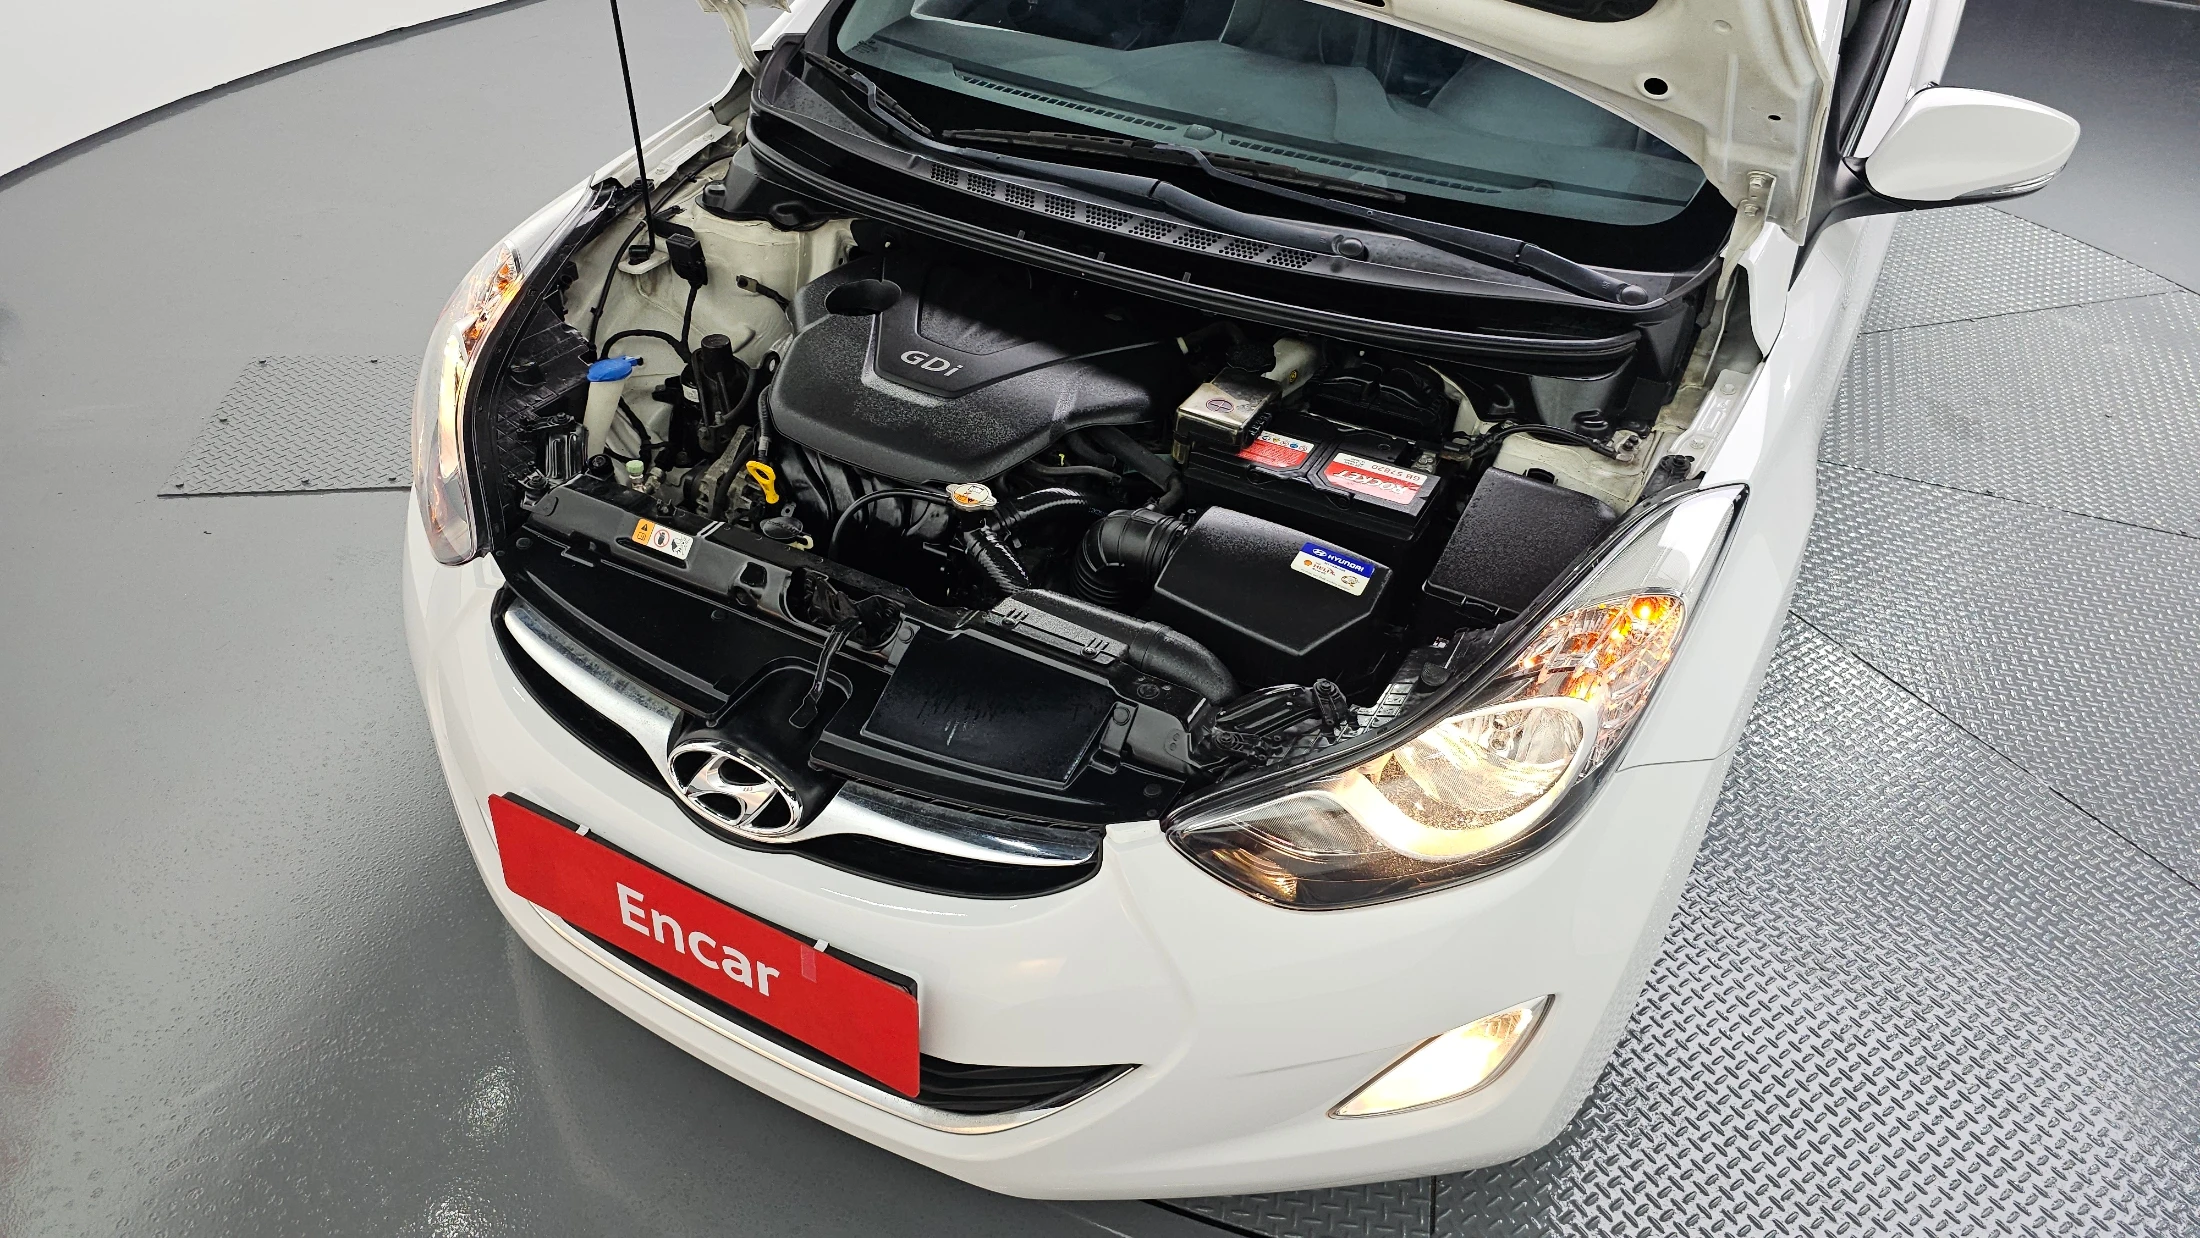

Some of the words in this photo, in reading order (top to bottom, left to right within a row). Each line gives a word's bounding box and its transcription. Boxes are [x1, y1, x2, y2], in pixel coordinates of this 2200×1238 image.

[901, 350, 963, 377] GDi
[1333, 469, 1408, 495] ROCKET
[1405, 474, 1421, 482] GB
[1327, 554, 1365, 573] HYUNDAI
[616, 881, 780, 997] Encar
